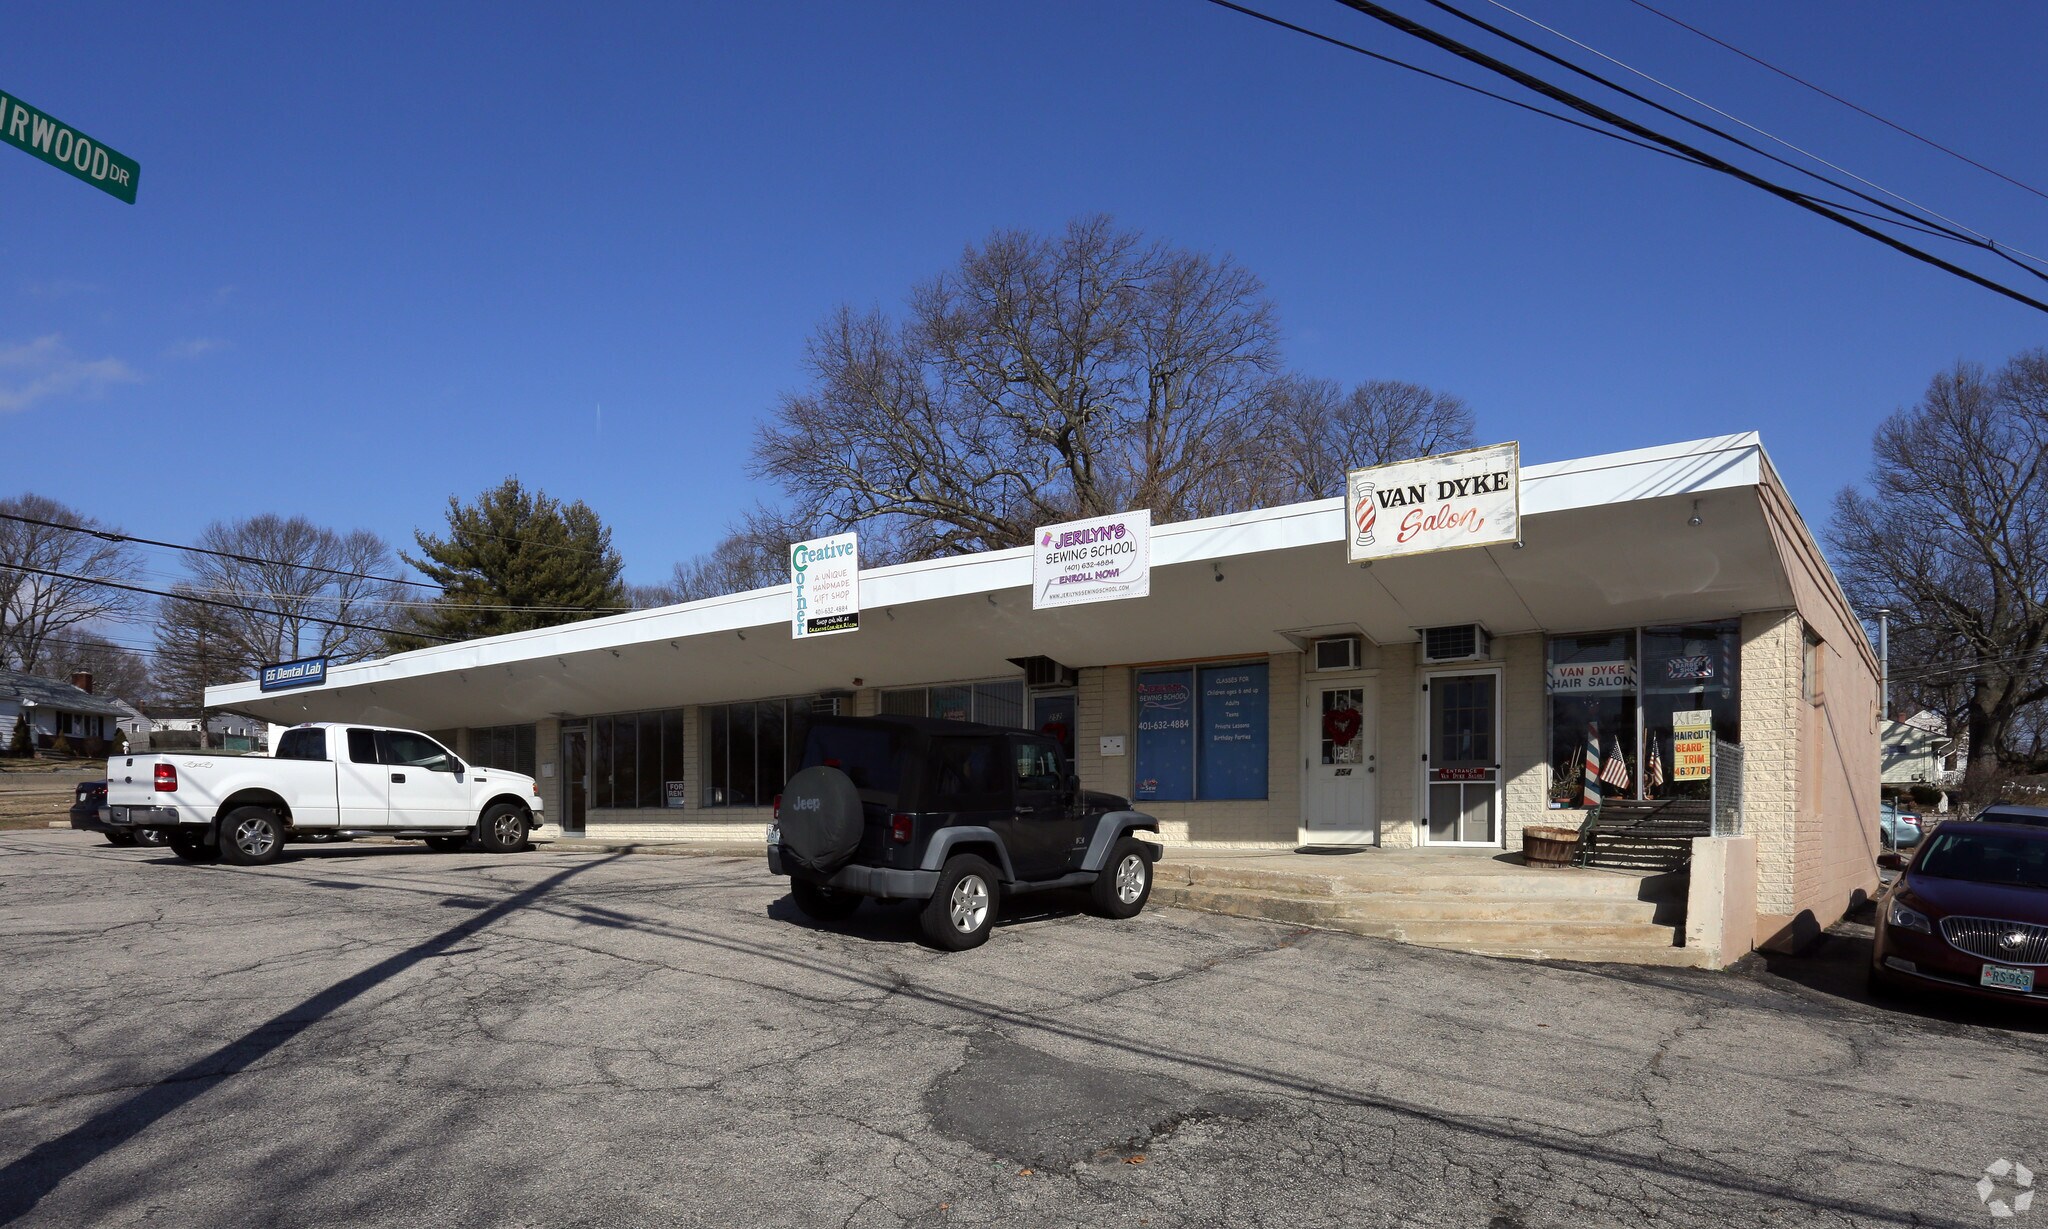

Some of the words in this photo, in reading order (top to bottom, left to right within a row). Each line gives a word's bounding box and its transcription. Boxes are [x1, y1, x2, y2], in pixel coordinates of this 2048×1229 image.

[109, 164, 130, 186] DR
[1377, 484, 1426, 509] VAN
[1437, 471, 1509, 500] DYKE
[1397, 503, 1484, 543] Salon
[1055, 523, 1125, 549] JERILYN'S
[793, 540, 853, 572] Creative
[1046, 547, 1087, 565] SEWING
[1090, 541, 1135, 558] SCHOOL
[1064, 563, 1081, 573] (401)
[1081, 559, 1114, 571] 632-4884
[814, 574, 819, 582] A
[821, 569, 847, 580] UNIQUE
[1059, 572, 1093, 585] ENROLL
[1095, 568, 1119, 580] NOW!
[812, 579, 850, 592] HANDMADE
[814, 594, 828, 604] GIFT
[831, 590, 850, 601] SHOP
[265, 669, 276, 682] EG
[276, 664, 305, 680] Dental
[305, 662, 321, 675] Lab
[1560, 667, 1584, 678] VAN
[1592, 664, 1625, 676] DYKE
[1216, 676, 1238, 684] CLASSES
[1553, 678, 1582, 689] HAIR
[1588, 676, 1631, 687] SALON
[1139, 694, 1162, 702] SEWING
[1163, 692, 1187, 701] SCHOOL
[1138, 720, 1189, 730] 401-632-4884
[1674, 730, 1710, 741] HAIRCUT
[1332, 747, 1354, 758] OPEN
[1683, 754, 1705, 764] TRIM
[1335, 768, 1352, 777] 254
[793, 795, 821, 812] Jeep
